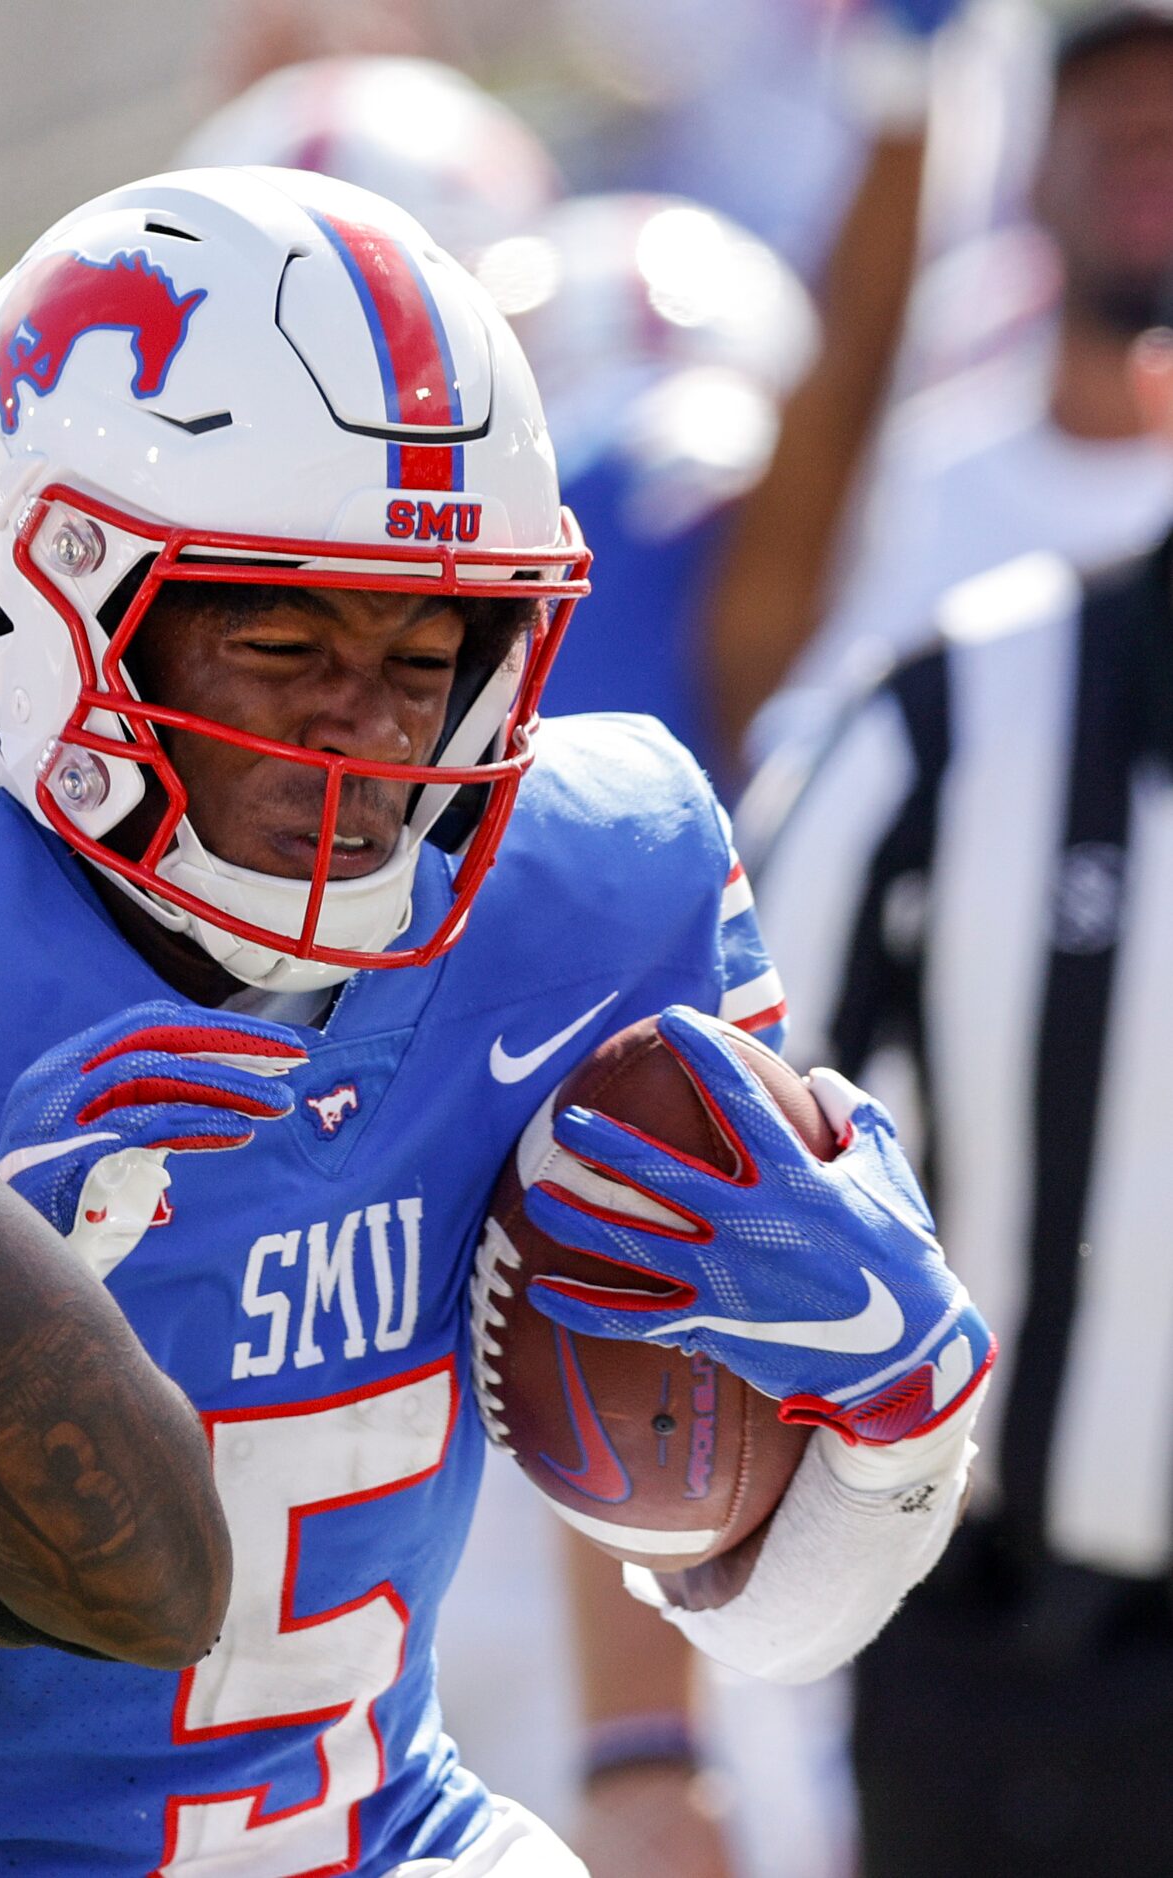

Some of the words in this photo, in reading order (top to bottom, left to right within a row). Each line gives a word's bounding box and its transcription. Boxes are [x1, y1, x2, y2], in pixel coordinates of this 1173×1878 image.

[385, 499, 482, 542] SMU
[231, 1197, 423, 1379] SMU
[148, 1352, 461, 1878] 5
